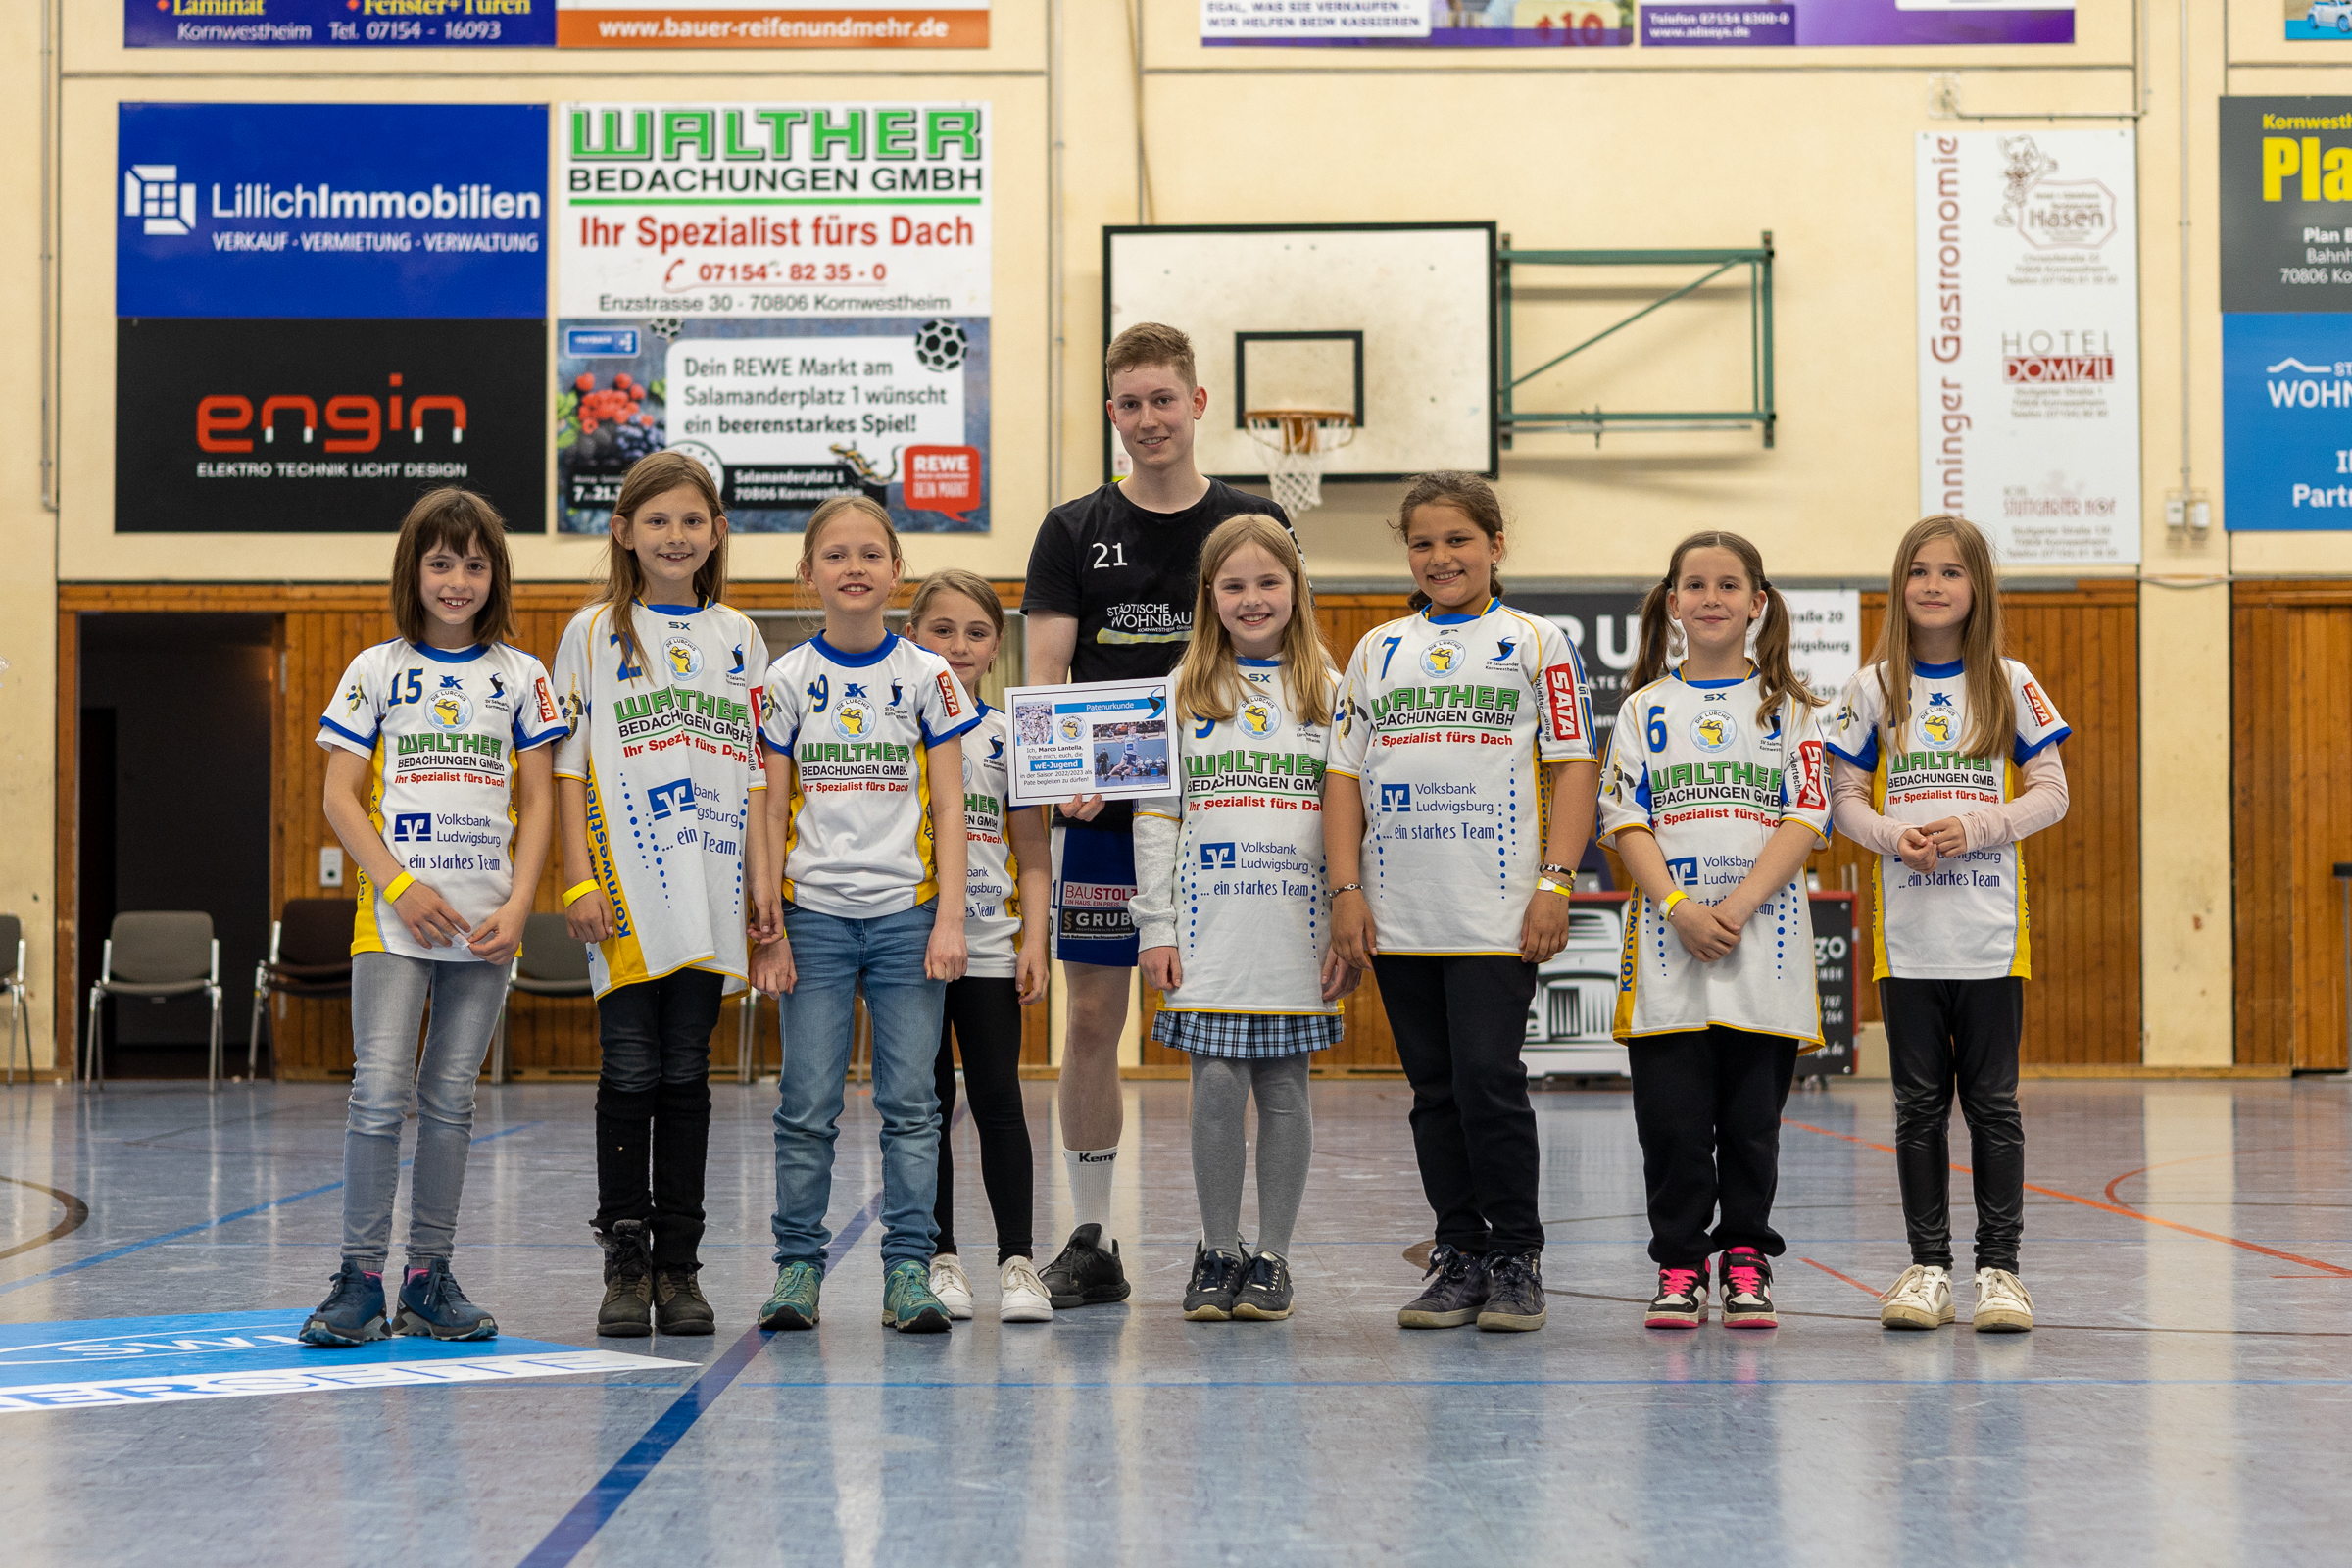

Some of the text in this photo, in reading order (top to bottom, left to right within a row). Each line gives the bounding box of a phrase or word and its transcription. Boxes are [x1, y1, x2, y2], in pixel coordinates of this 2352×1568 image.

[1318, 1, 1399, 12] VERKAUFEN
[1207, 17, 1420, 27] WIR HELFEN BEIM KASSIEREN
[1649, 13, 1697, 24] Telefon
[177, 22, 312, 40] Kornwestheim
[328, 21, 502, 40] Tel. 07154 16093
[599, 18, 949, 39] www.bauer-reifenundmehr.de
[568, 108, 983, 161] WALTHER
[569, 168, 982, 192] BEDACHUNGEN GMBH
[212, 183, 541, 219] LillichImmobilien
[2029, 208, 2105, 228] Hasen
[212, 231, 539, 252] VERKAUF VERMIETUNG VERWALTUNG
[580, 215, 974, 255] Ihr Spezialist fürs Dach
[2303, 227, 2341, 243] Plan
[1930, 136, 1961, 364] Gastronomie
[699, 263, 887, 281] 07154 82 35 0
[2279, 268, 2328, 284] 70806
[600, 294, 951, 312] Enzstrasse 30 70806 Kornwestheim
[2001, 329, 2114, 356] HOTEL
[685, 358, 893, 377] Dein REWE Markt am
[2005, 357, 2114, 381] DOMIZIL
[684, 386, 948, 411] Salamanderplatz 1 wünscht
[197, 373, 467, 453] engin
[685, 414, 916, 437] ein beerenstarkes Spiel!
[196, 462, 467, 478] ELEKTRO TECHNIK LICHT DESIGN
[913, 455, 970, 472] REWE
[734, 470, 833, 486] Salamanderplatz
[734, 486, 777, 501] 70806
[1092, 542, 1128, 569] 21
[1106, 603, 1170, 616] STÄDTISCHE
[1828, 612, 1844, 623] 20
[1111, 611, 1192, 628] WOHNBAU
[1381, 635, 1403, 682] 7
[387, 667, 424, 708] 15
[1370, 684, 1520, 721] WALTHER
[1550, 671, 1578, 736] SATA
[1703, 692, 1728, 702] SX
[2027, 685, 2051, 724] SATA
[1086, 702, 1135, 711] Patenurkunde
[1471, 710, 1515, 726] GMBH
[1647, 705, 1669, 754] 6
[397, 732, 503, 760] WALTHER
[623, 738, 717, 758] Ihr fürs
[1381, 730, 1513, 748] Spezialist fürs Dach
[801, 742, 910, 763] WALTHER
[397, 755, 478, 769] BEDACHUNGEN
[802, 764, 908, 777] BEDACHUNGEN GMBH
[1034, 760, 1078, 770] wE-Jugend
[1184, 750, 1327, 783] WALTHER
[394, 771, 505, 788] Ihr Spezialist fürs Dach
[815, 781, 908, 795] Spezialist fürs Dach
[1187, 774, 1288, 793] BEDACHUNGEN
[1888, 772, 1969, 789] BEDACHUNGEN
[1415, 782, 1477, 796] Volksbank
[1903, 789, 1978, 804] Spezialist fürs
[1270, 797, 1297, 811] fürs
[1416, 799, 1494, 815] Ludwigsburg
[436, 813, 492, 828] Volksbank
[1663, 808, 1759, 826] Spezialist fürs
[436, 830, 501, 848] Ludwigsburg
[1395, 821, 1494, 840] ein starkes Team
[703, 831, 736, 856] Team
[1240, 842, 1297, 856] Volksbank
[409, 853, 501, 871] ein starkes Team
[1240, 858, 1309, 874] Ludwigsburg
[1907, 868, 2000, 888] ein starkes Team
[1065, 884, 1138, 902] BAUSTOLZ
[1213, 879, 1309, 897] ein starkes Team
[1075, 912, 1132, 927] GRUB
